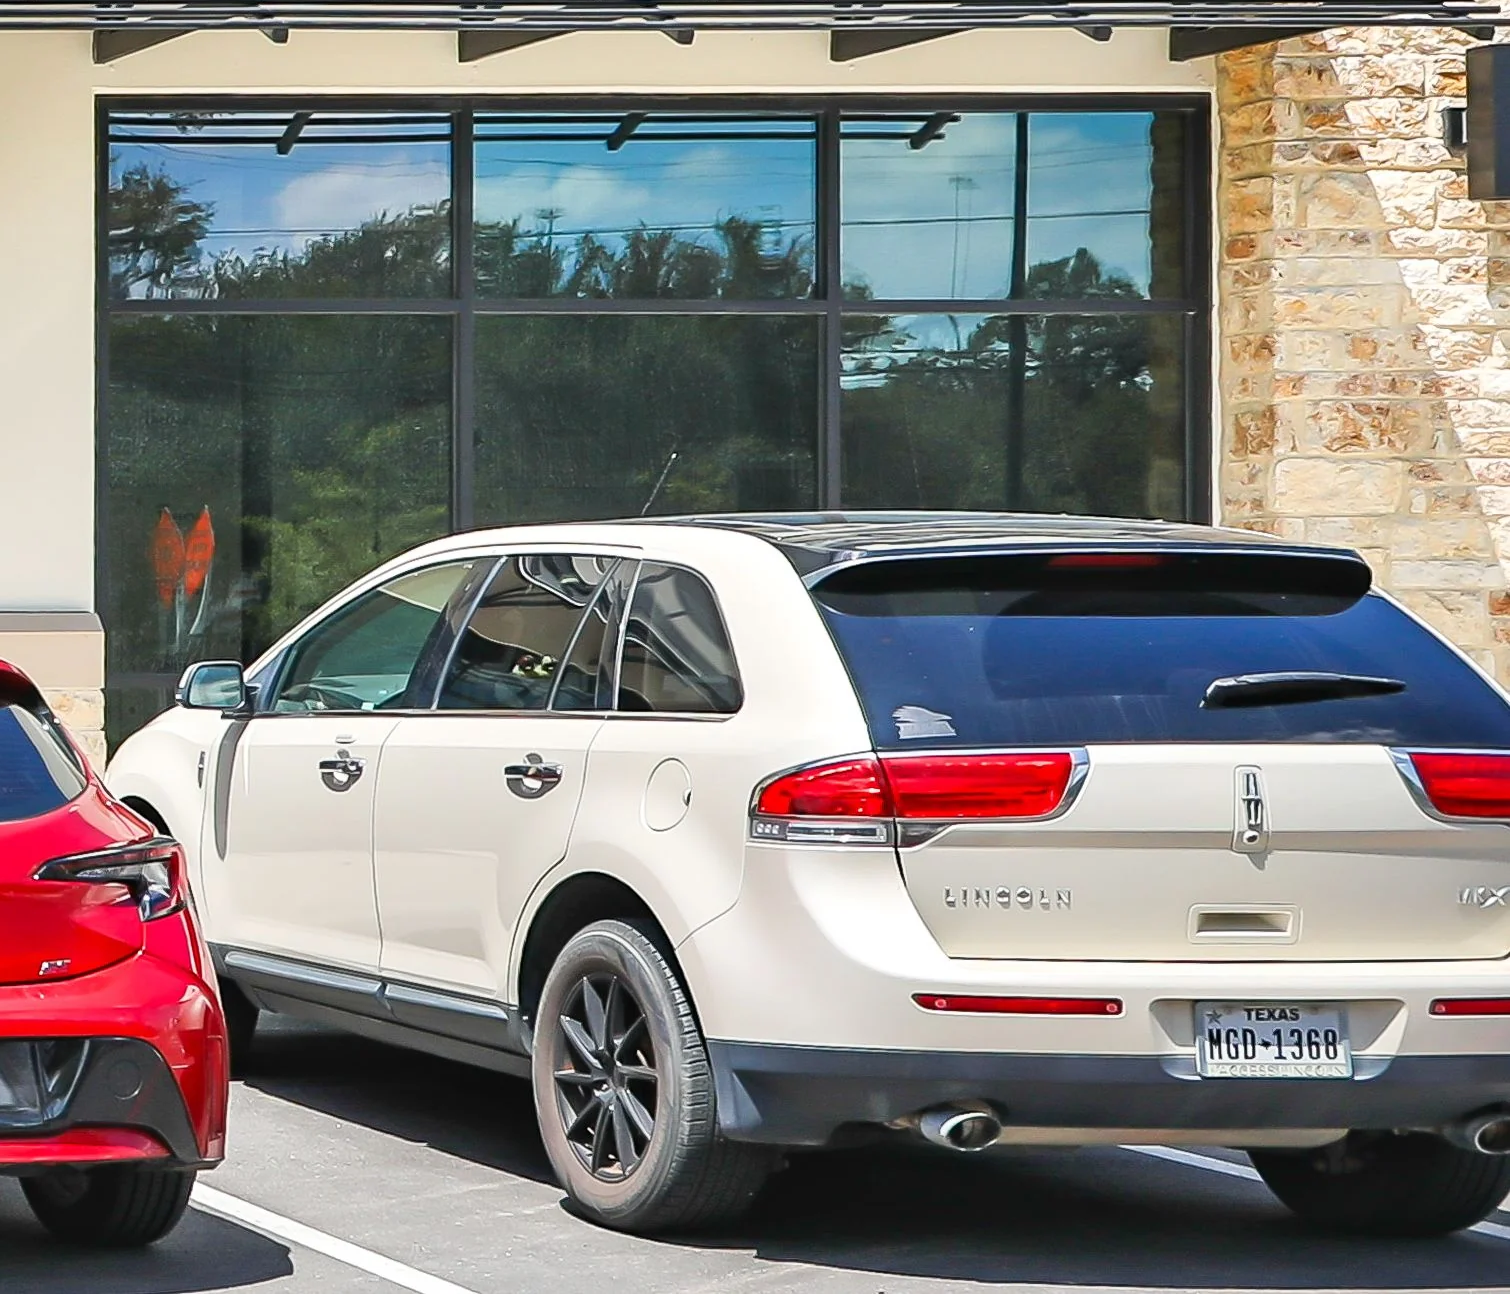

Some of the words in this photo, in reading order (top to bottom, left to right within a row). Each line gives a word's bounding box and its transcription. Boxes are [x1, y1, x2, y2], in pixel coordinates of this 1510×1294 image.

[944, 886, 1072, 909] LINCOLN
[1243, 1007, 1301, 1022] TEXAS
[1207, 1027, 1257, 1061] MGD
[1272, 1027, 1339, 1061] 1368
